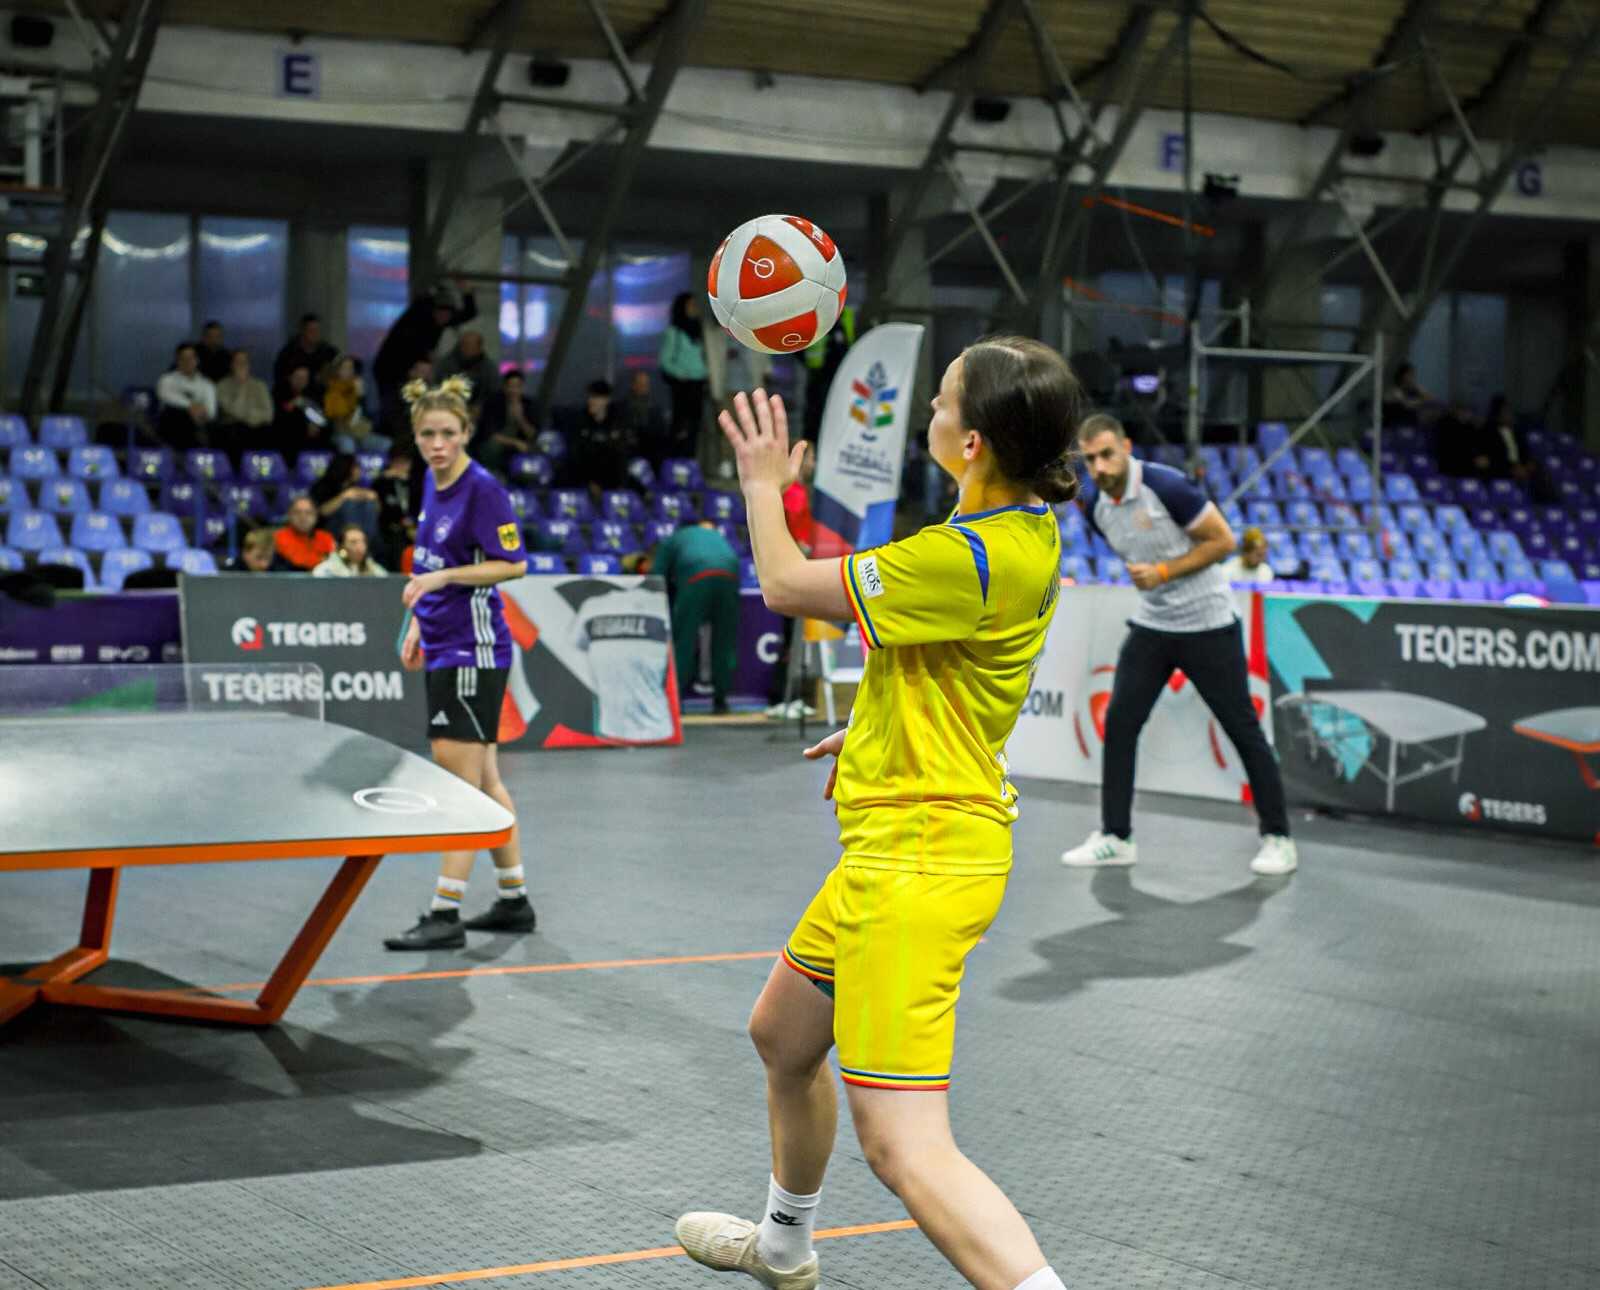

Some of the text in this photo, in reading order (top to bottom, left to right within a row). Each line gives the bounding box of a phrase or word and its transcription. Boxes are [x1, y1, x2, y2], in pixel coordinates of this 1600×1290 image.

[284, 54, 312, 96] E
[1518, 164, 1541, 198] G
[267, 621, 367, 648] TEQERS
[1394, 623, 1600, 672] TEQERS.COM
[202, 670, 404, 704] TEQERS.COM
[1482, 797, 1547, 826] TEQERS
